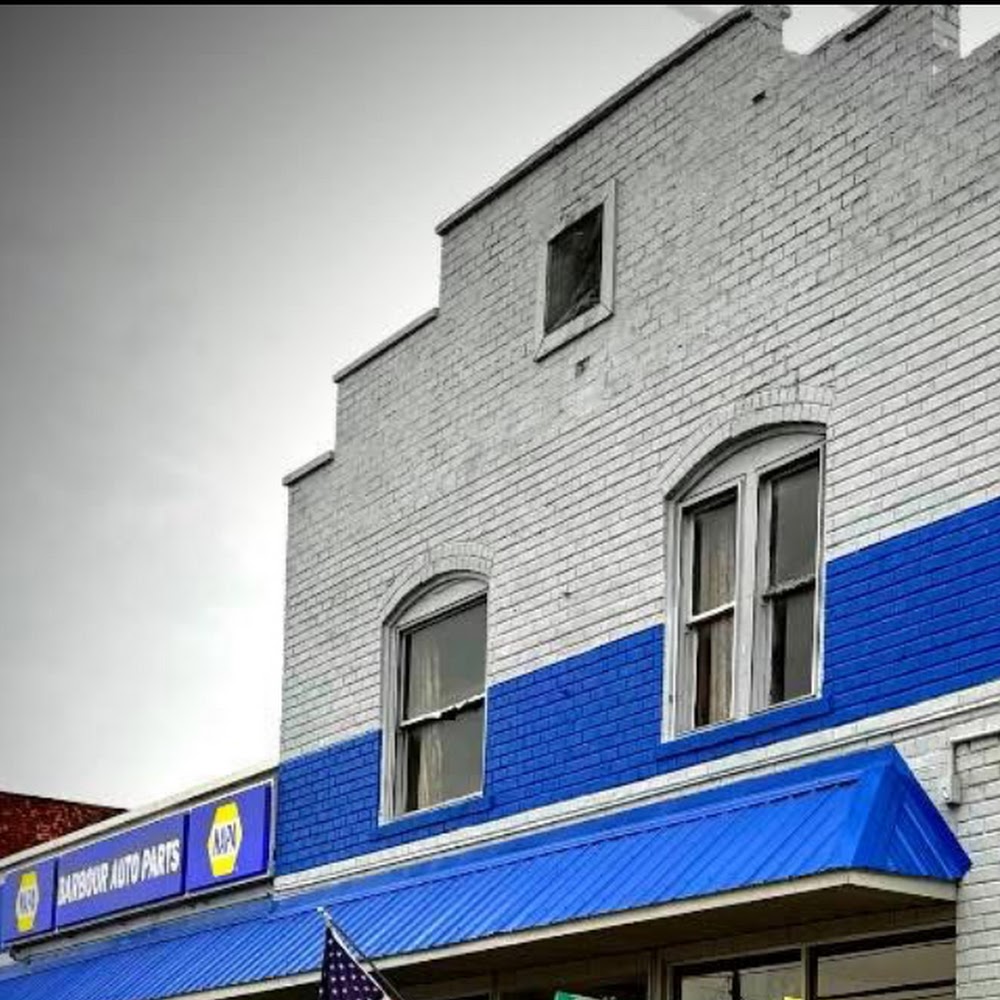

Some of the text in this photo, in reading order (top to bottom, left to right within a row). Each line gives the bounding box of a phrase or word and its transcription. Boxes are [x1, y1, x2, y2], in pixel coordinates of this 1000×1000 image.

[57, 838, 181, 907] BARBOUR AUTO PARTS
